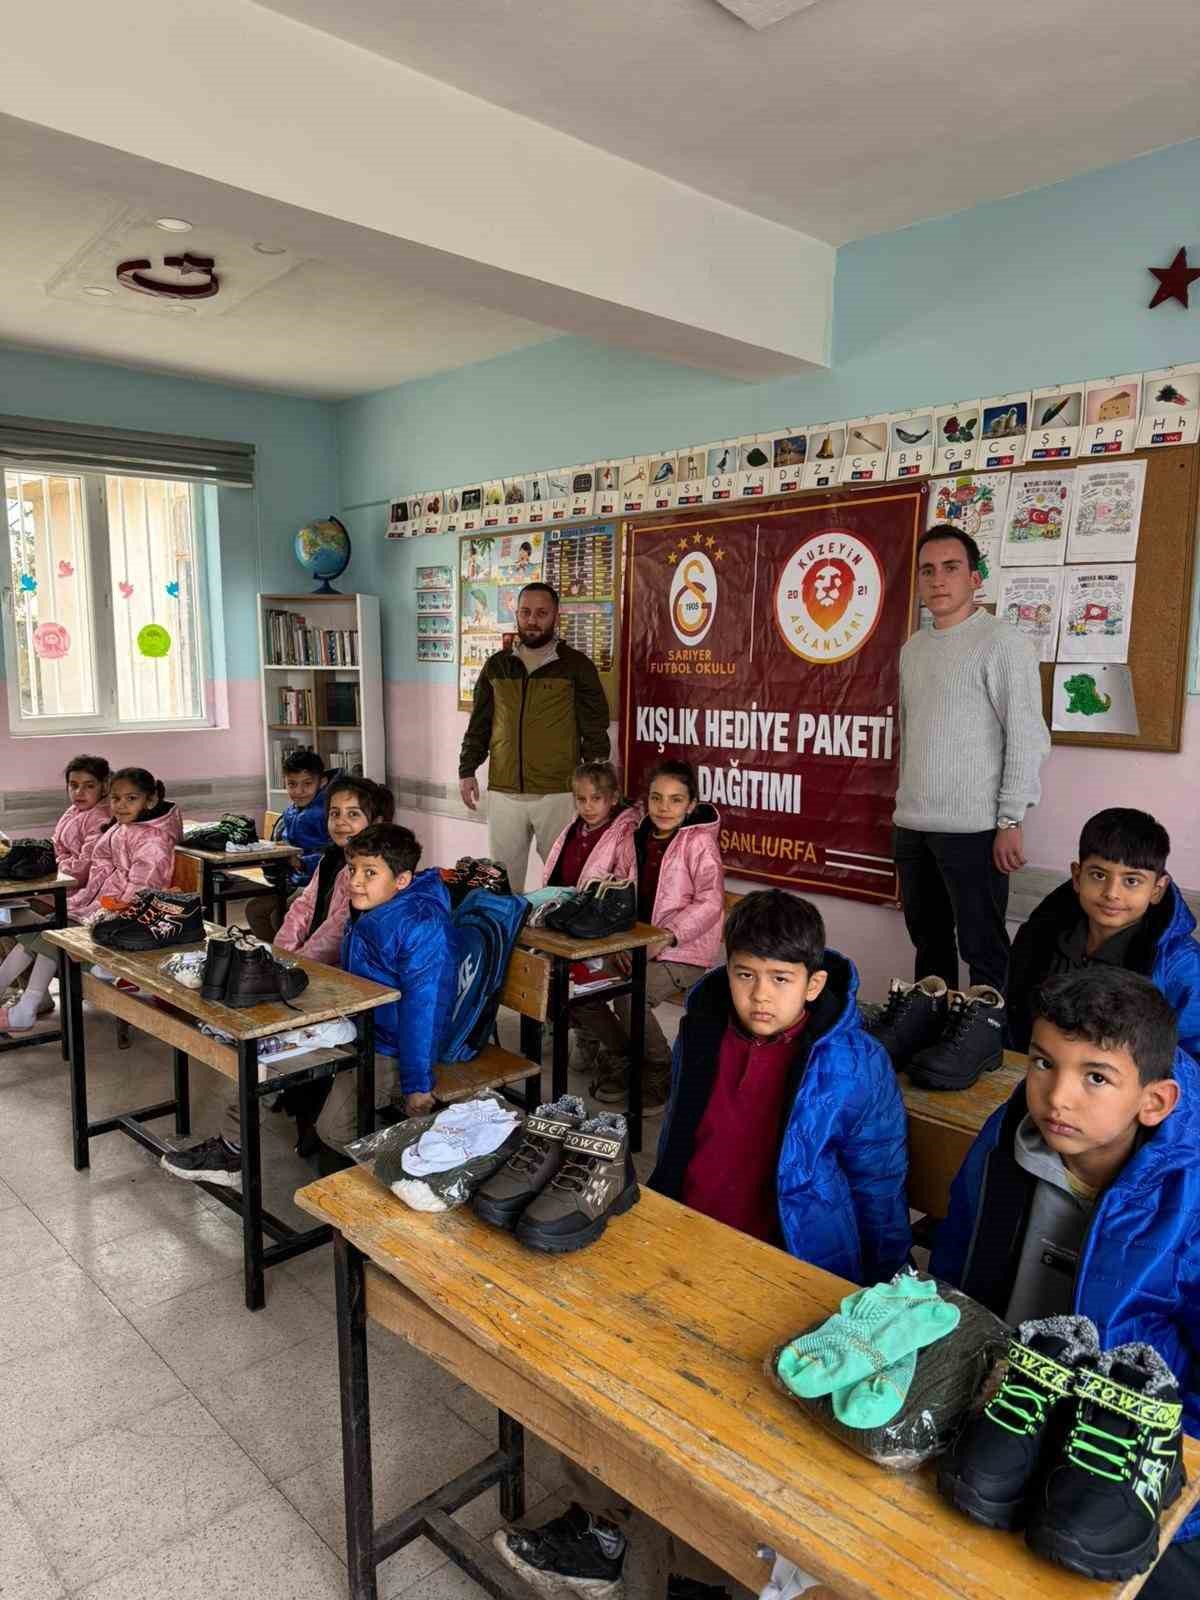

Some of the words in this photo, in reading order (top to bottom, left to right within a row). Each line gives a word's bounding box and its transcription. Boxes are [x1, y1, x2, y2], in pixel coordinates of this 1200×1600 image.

[1153, 418, 1166, 430] H
[1096, 427, 1104, 439] P
[1041, 433, 1050, 447] Ş
[988, 441, 999, 453] C
[899, 453, 906, 464] B
[944, 449, 955, 460] G
[779, 470, 787, 480] D
[814, 464, 822, 475] Z
[745, 473, 752, 483] Y
[684, 483, 690, 494] S
[798, 542, 863, 570] KUZEYİN
[787, 590, 799, 600] 20
[857, 585, 868, 596] 21
[790, 610, 864, 651] ASLANLARI
[668, 649, 712, 661] SARIYER
[651, 662, 692, 674] FUTBOL
[695, 662, 736, 674] OKULU
[636, 705, 700, 753] KIŞLIK
[704, 701, 790, 753] HEDİYE
[797, 705, 894, 760] PAKETİ
[698, 758, 802, 815] DAĞITIMI
[720, 829, 817, 864] ŞANLIURFA
[528, 1119, 567, 1137] OWER
[1009, 1348, 1069, 1386] OWER
